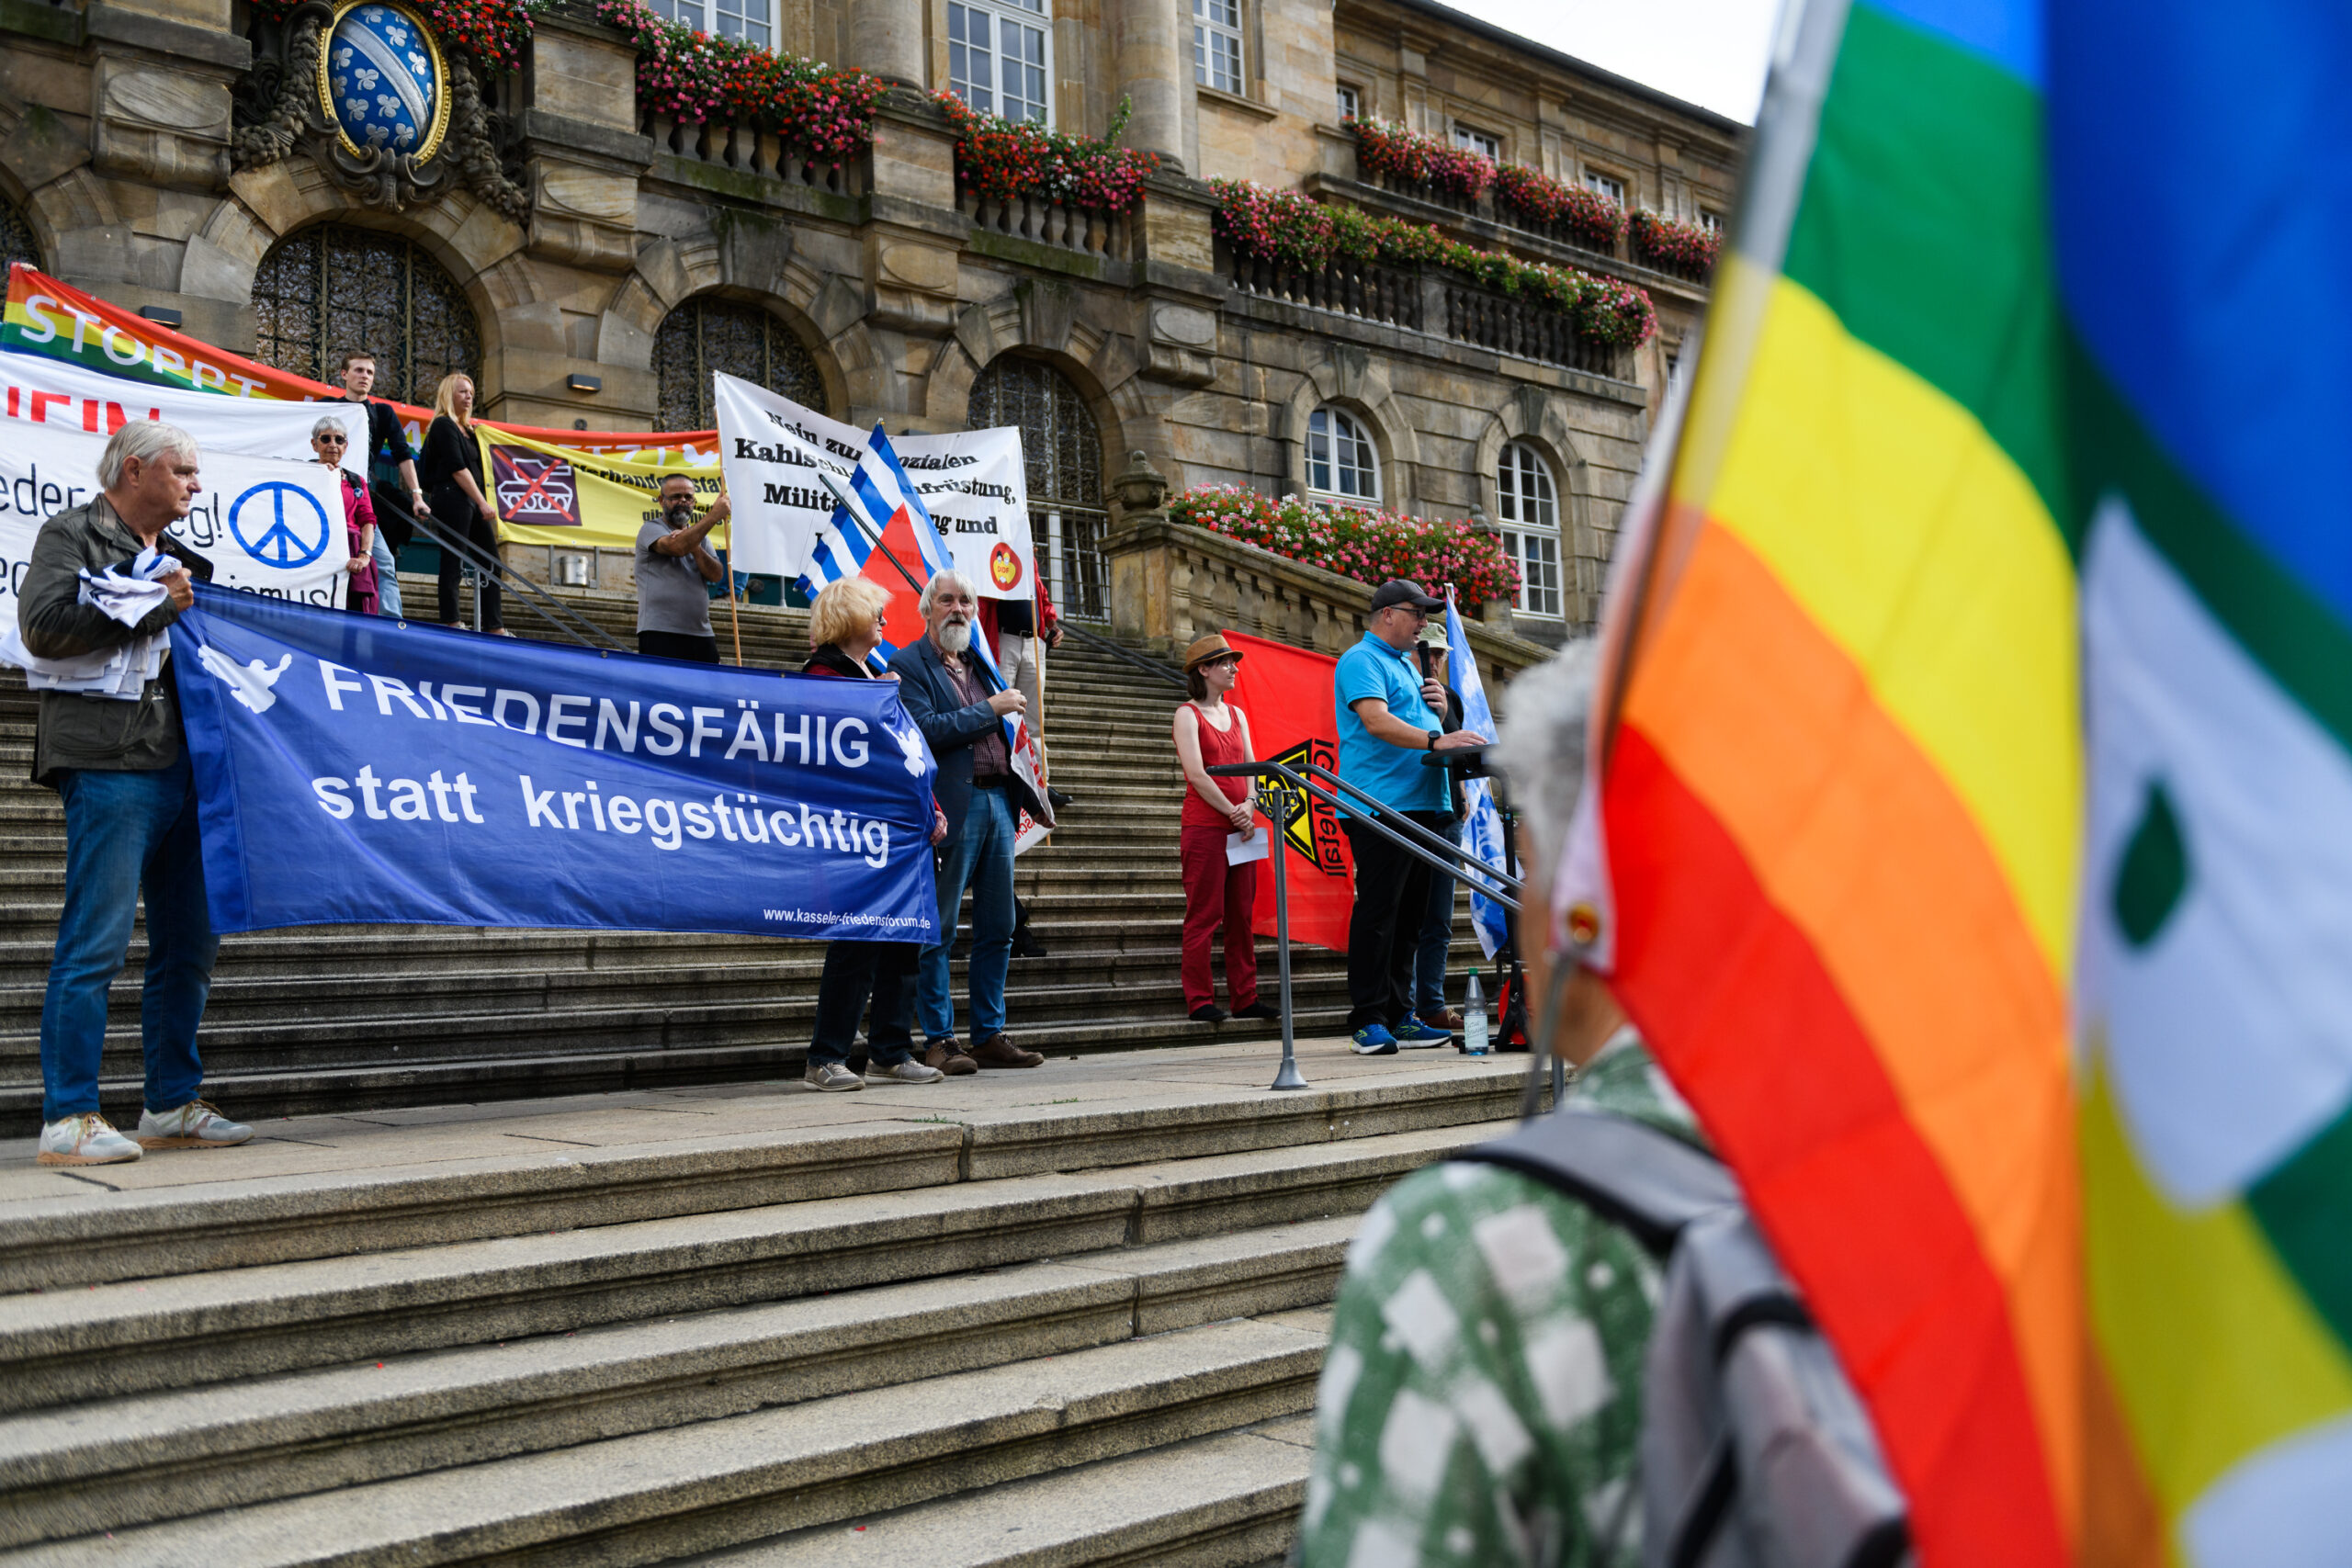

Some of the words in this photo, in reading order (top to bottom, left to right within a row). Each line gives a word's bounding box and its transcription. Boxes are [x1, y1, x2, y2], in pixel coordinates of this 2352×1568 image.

[20, 294, 266, 398] STOPPT
[735, 437, 854, 479] Kahlschl
[764, 410, 820, 446] Nein
[825, 438, 863, 462] zu
[898, 453, 980, 471] ozialen
[956, 515, 999, 535] und
[318, 659, 870, 769] FRIEDENSFÄHIG
[311, 764, 485, 825] statt
[519, 775, 889, 869] kriegstüchtig
[763, 908, 931, 930] www.kasseler-friedensforum.de
